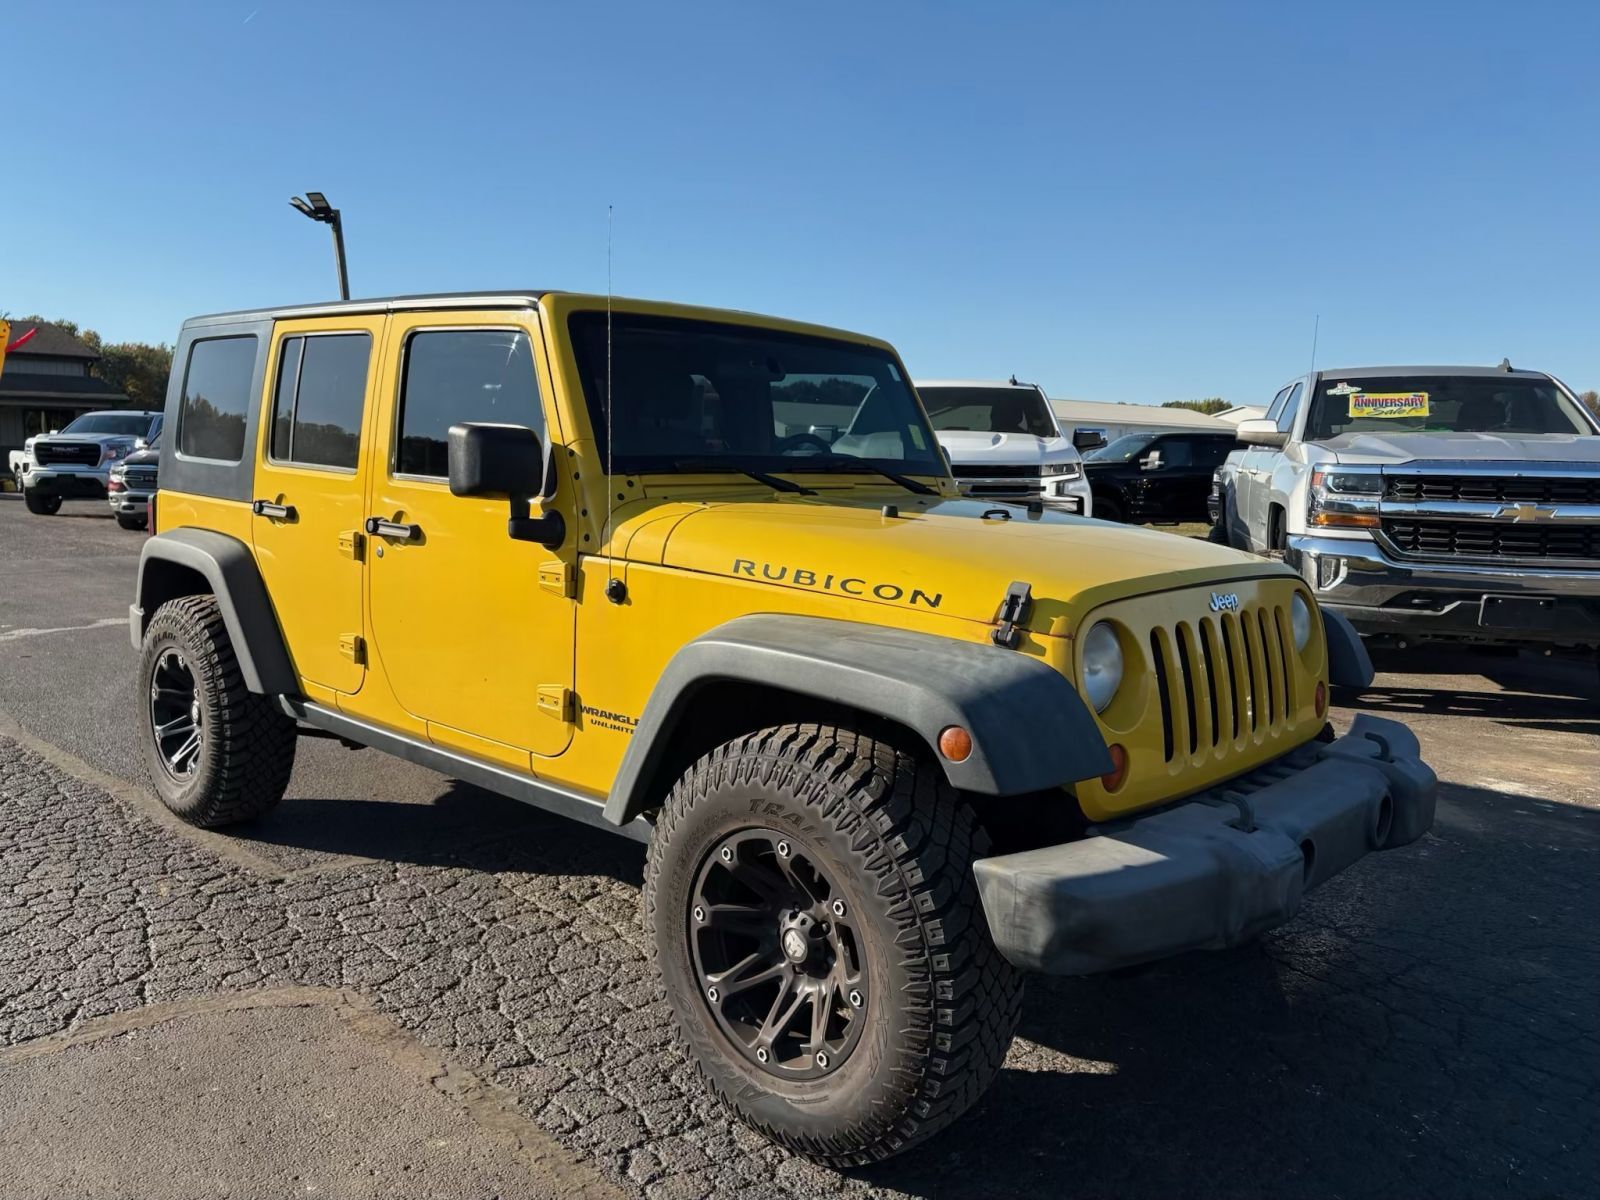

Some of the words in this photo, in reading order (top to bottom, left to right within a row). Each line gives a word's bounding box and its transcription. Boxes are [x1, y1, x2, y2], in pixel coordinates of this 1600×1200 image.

[1354, 396, 1424, 408] ANNIVERSARY
[732, 558, 943, 608] RUBICON
[1209, 591, 1239, 612] Jeep
